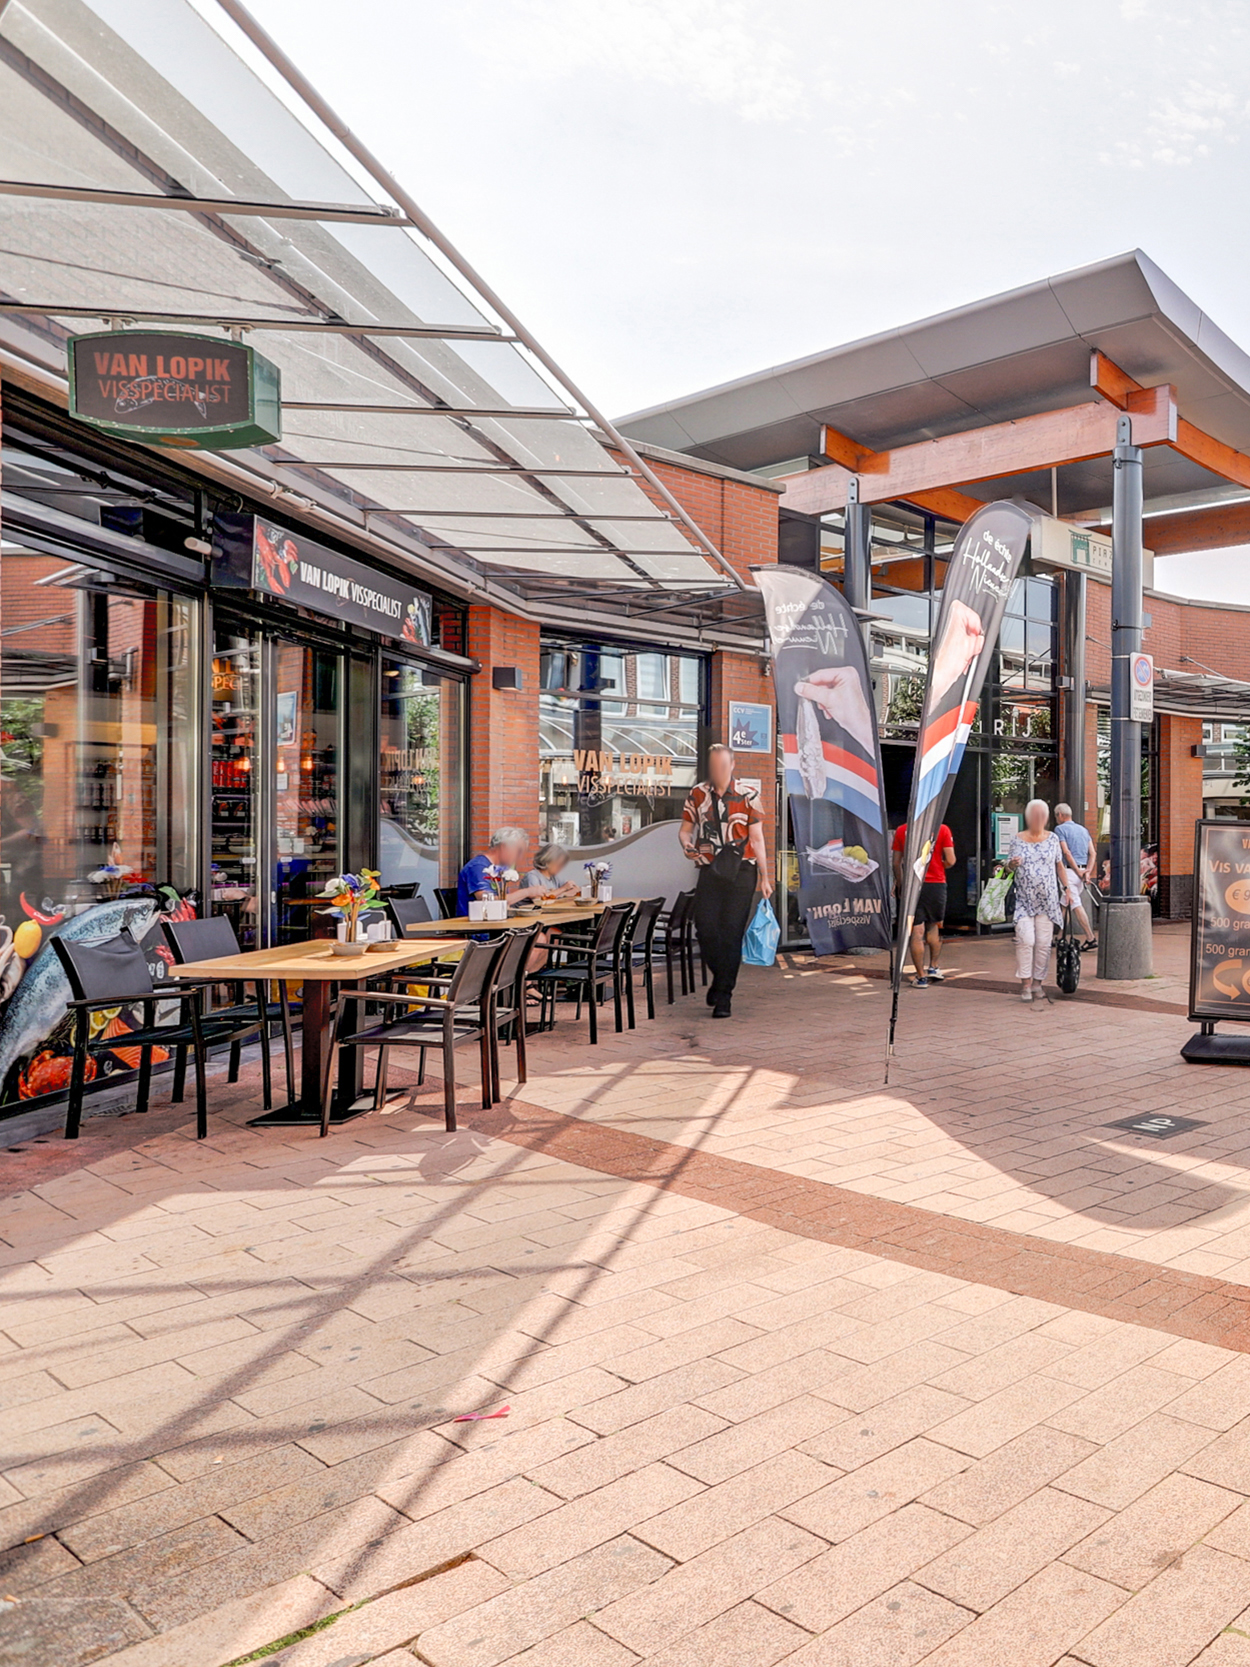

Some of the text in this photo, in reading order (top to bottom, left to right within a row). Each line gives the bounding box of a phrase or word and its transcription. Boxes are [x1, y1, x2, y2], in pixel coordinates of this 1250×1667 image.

[93, 352, 231, 382] VAN LOPIK
[97, 379, 231, 404] VISSPECIALIST
[982, 530, 994, 546] de
[962, 536, 1009, 583] Hollandse
[300, 561, 402, 619] VAN LOPIK VISSPECIALIST
[573, 749, 673, 776] VAN LOPIK
[576, 774, 673, 797] VISSPECIALIST
[1232, 889, 1241, 900] €
[1210, 916, 1230, 929] 500
[1205, 943, 1225, 955] 500
